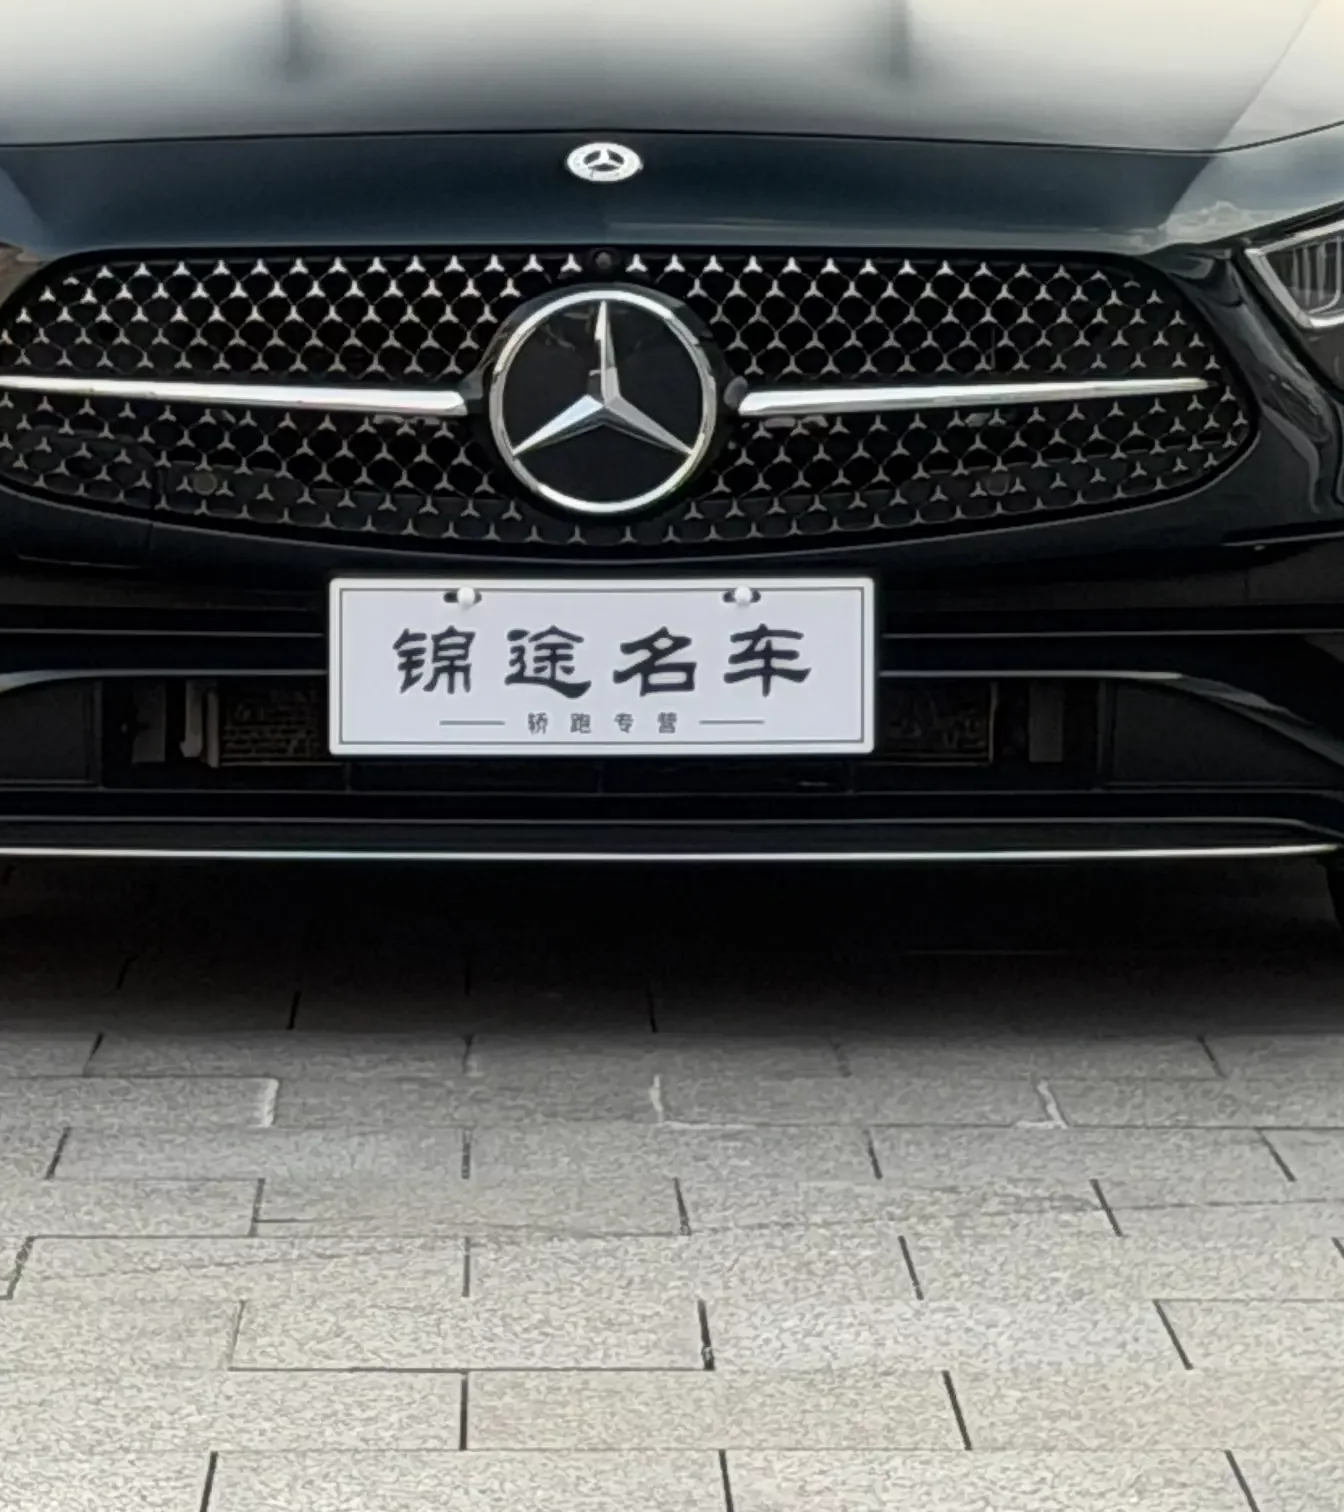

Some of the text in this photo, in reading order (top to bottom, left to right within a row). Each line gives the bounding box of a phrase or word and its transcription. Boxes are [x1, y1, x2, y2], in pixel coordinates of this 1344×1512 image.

[392, 623, 813, 698] 锦途名车
[527, 711, 678, 735] 轿跑专营
